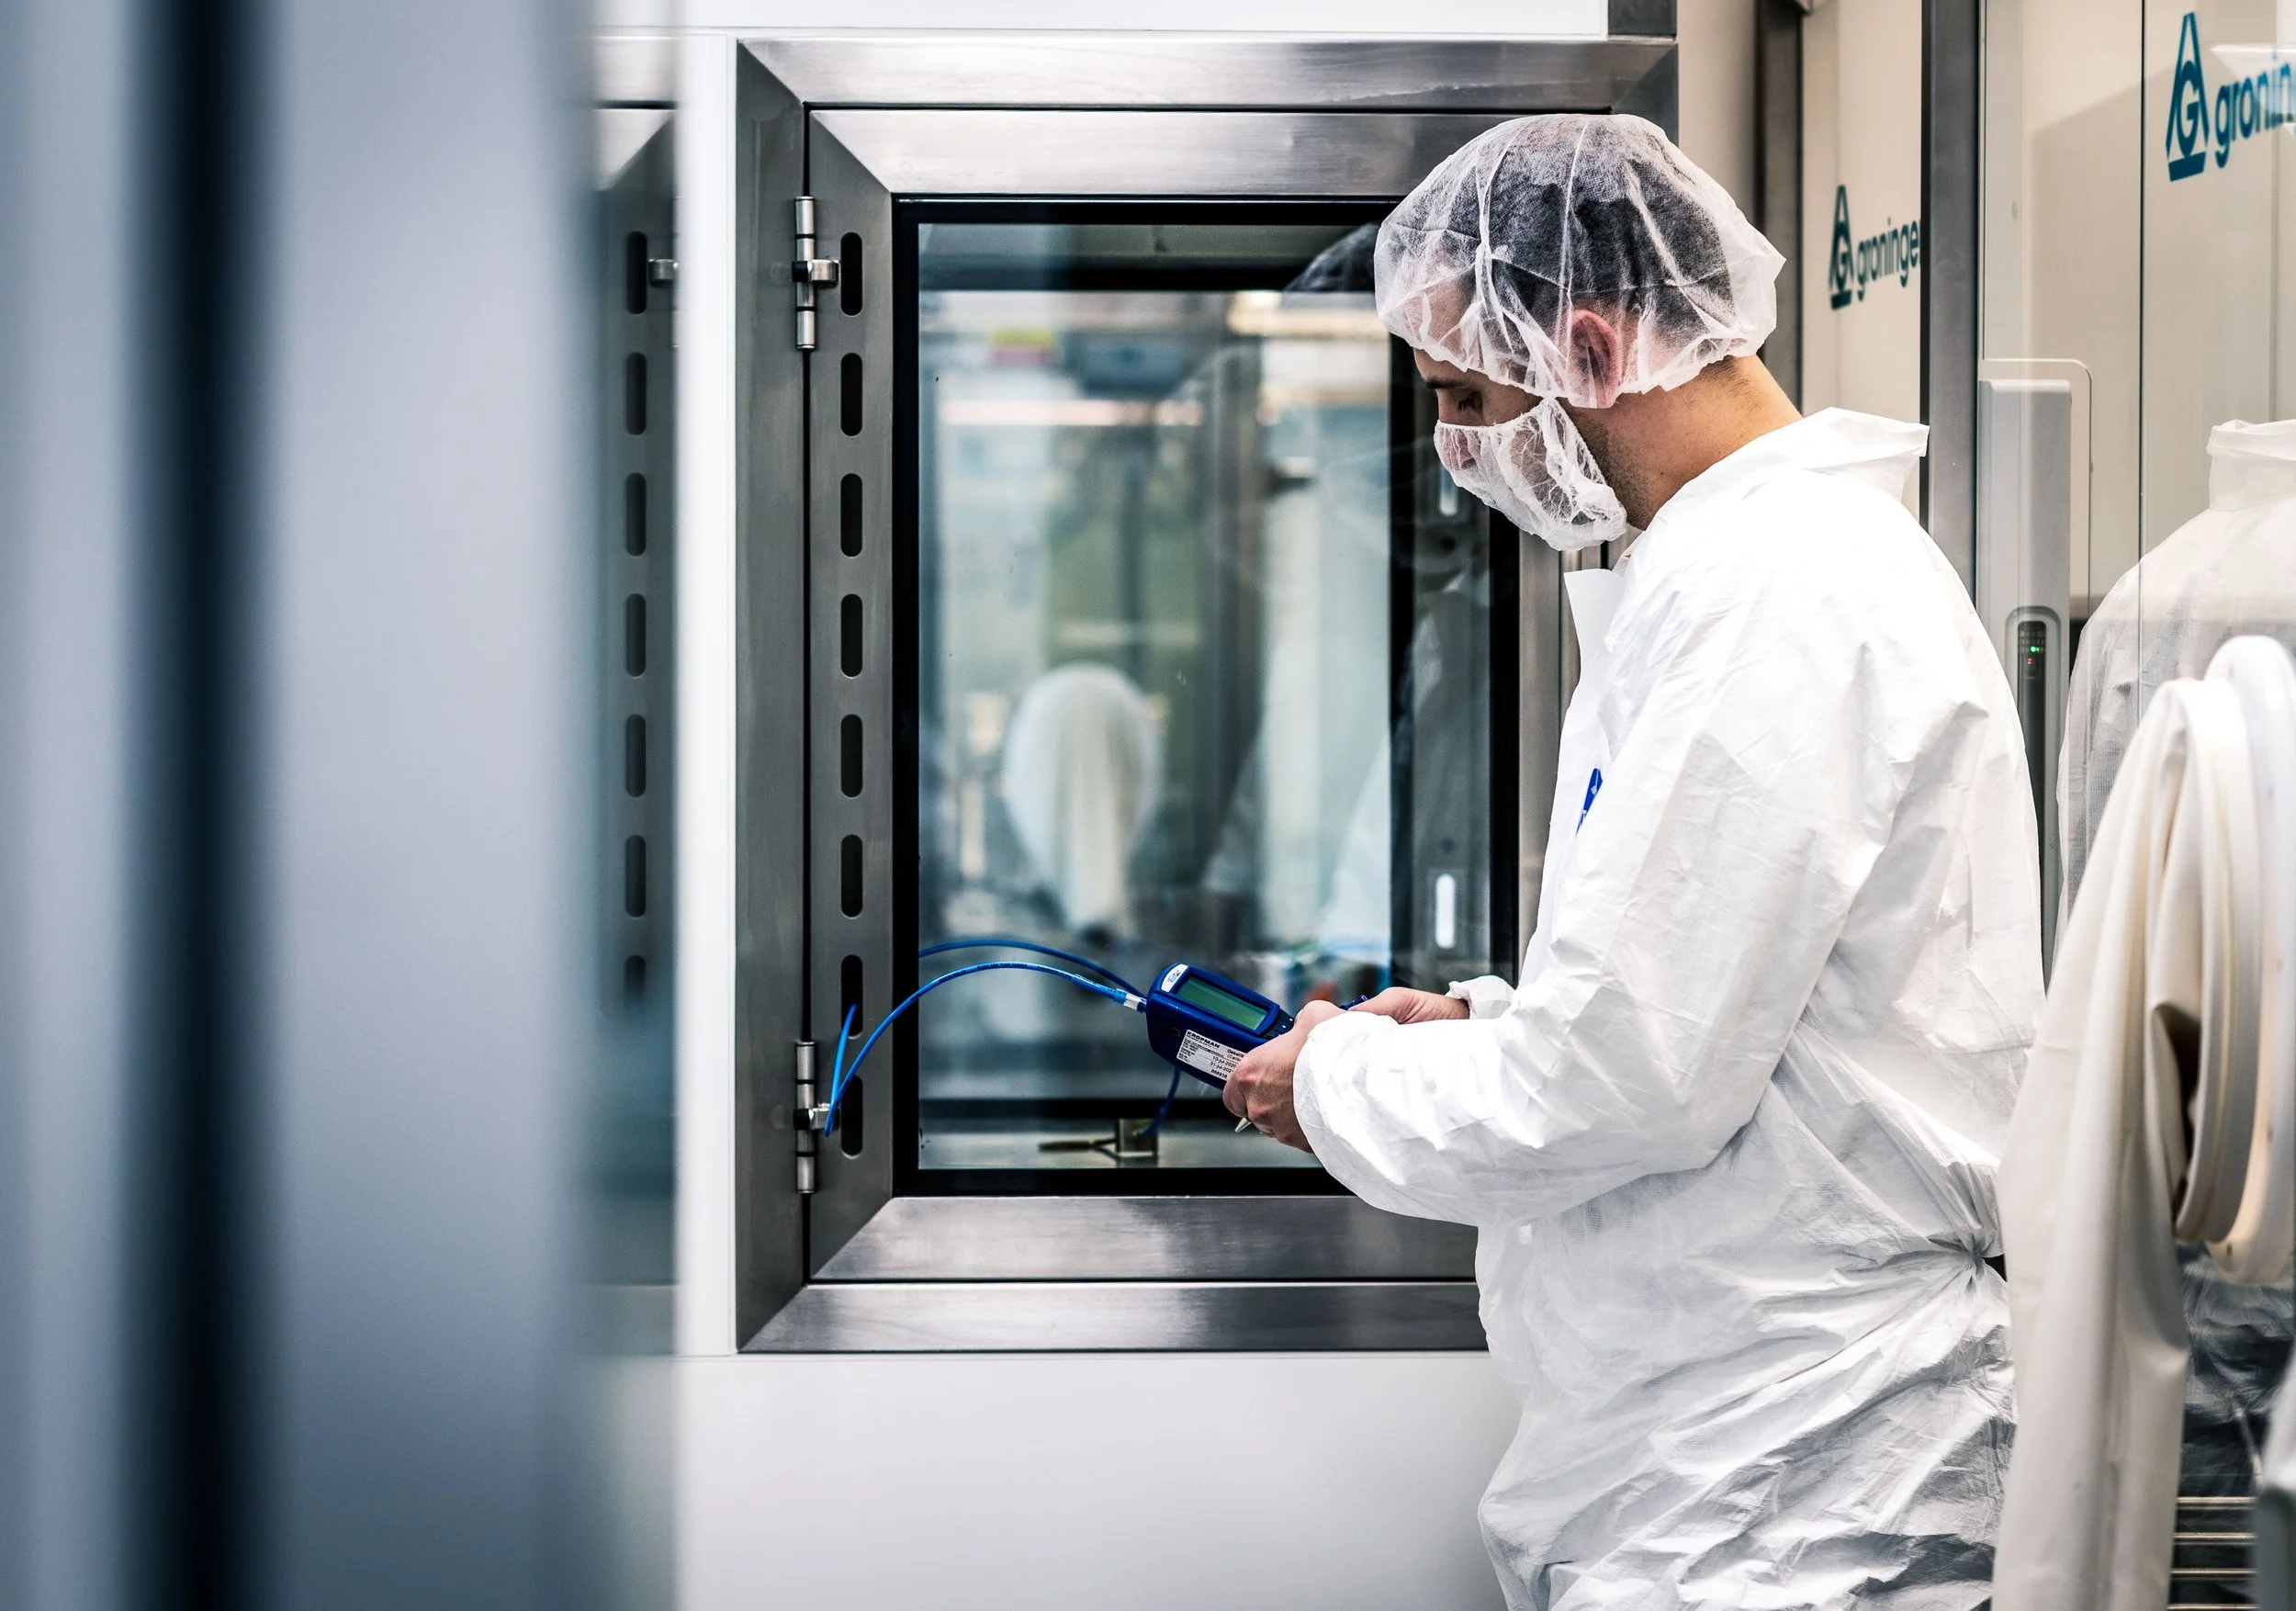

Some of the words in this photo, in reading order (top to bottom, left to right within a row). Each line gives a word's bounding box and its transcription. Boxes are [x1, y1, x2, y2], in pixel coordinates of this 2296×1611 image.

[2214, 50, 2296, 169] gronin
[1856, 215, 1920, 302] groninge
[1187, 1031, 1221, 1049] KROPMAN
